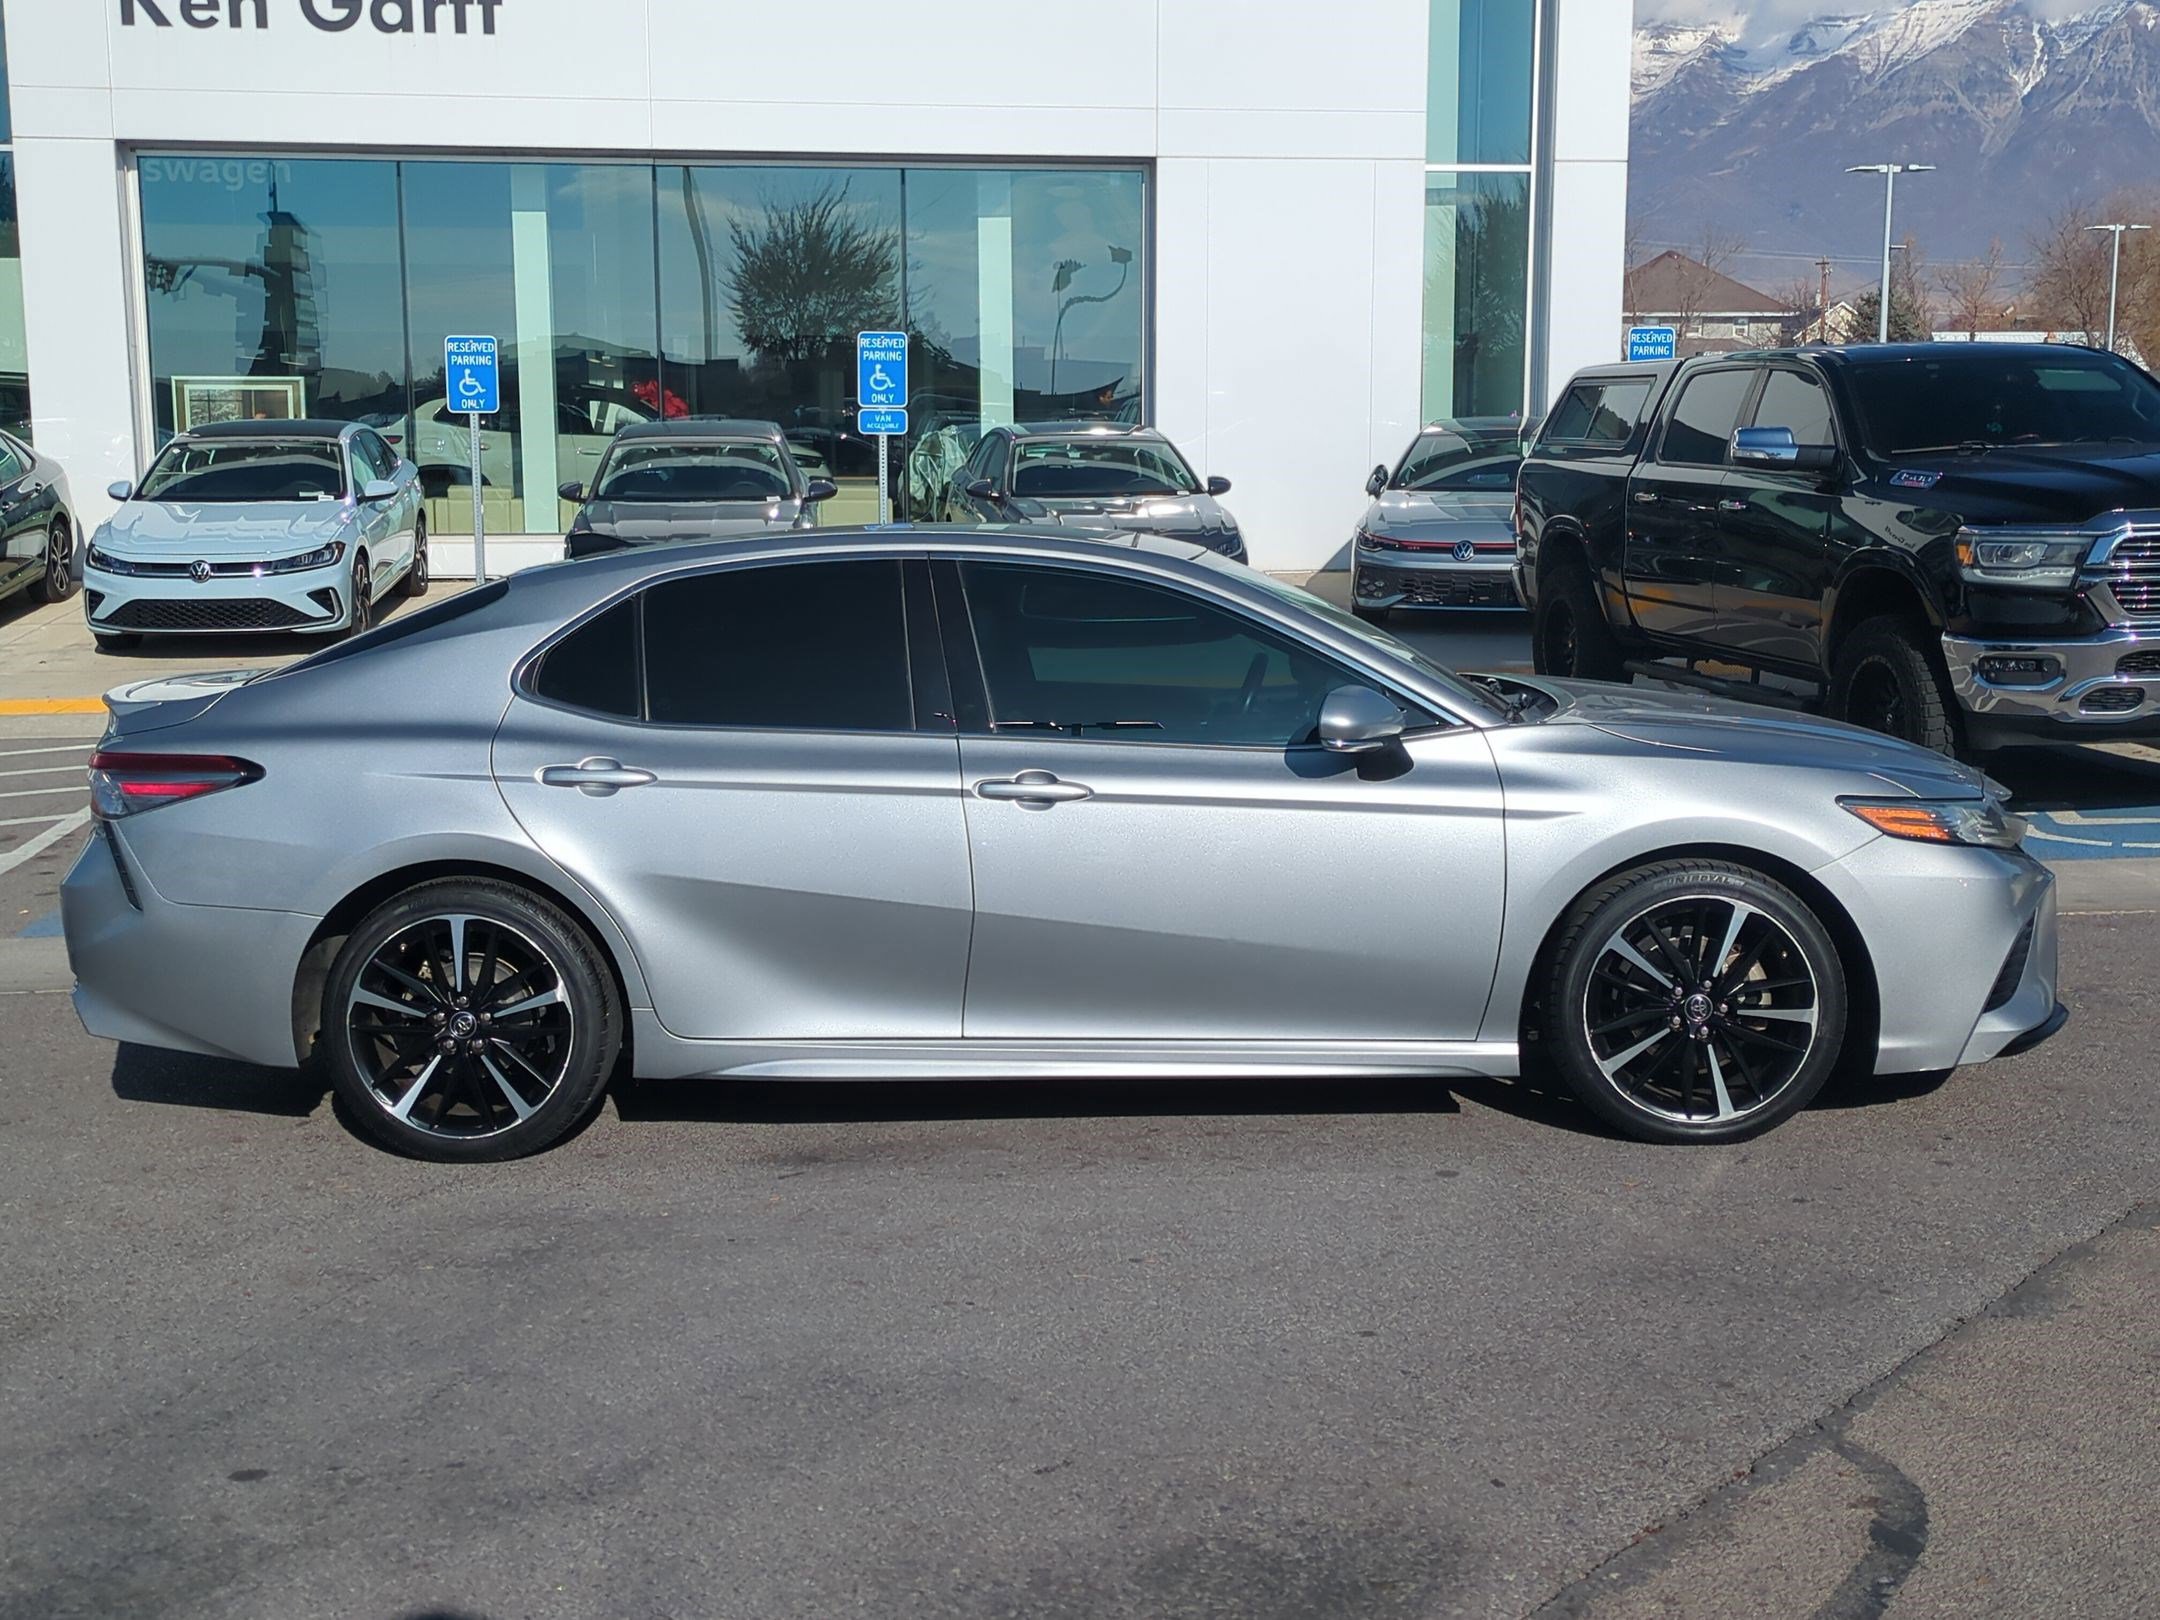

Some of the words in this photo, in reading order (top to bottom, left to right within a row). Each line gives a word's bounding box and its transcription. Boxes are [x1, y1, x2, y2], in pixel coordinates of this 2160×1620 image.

[860, 338, 905, 348] RESERVED
[1631, 333, 1673, 343] RESERVED
[447, 342, 495, 353] RESERVED
[1633, 345, 1670, 355] PARKING
[451, 355, 492, 366] PARKING
[863, 351, 902, 361] PARKING
[871, 393, 894, 403] ONLY
[461, 399, 486, 409] ONLY
[874, 414, 892, 422] VAN
